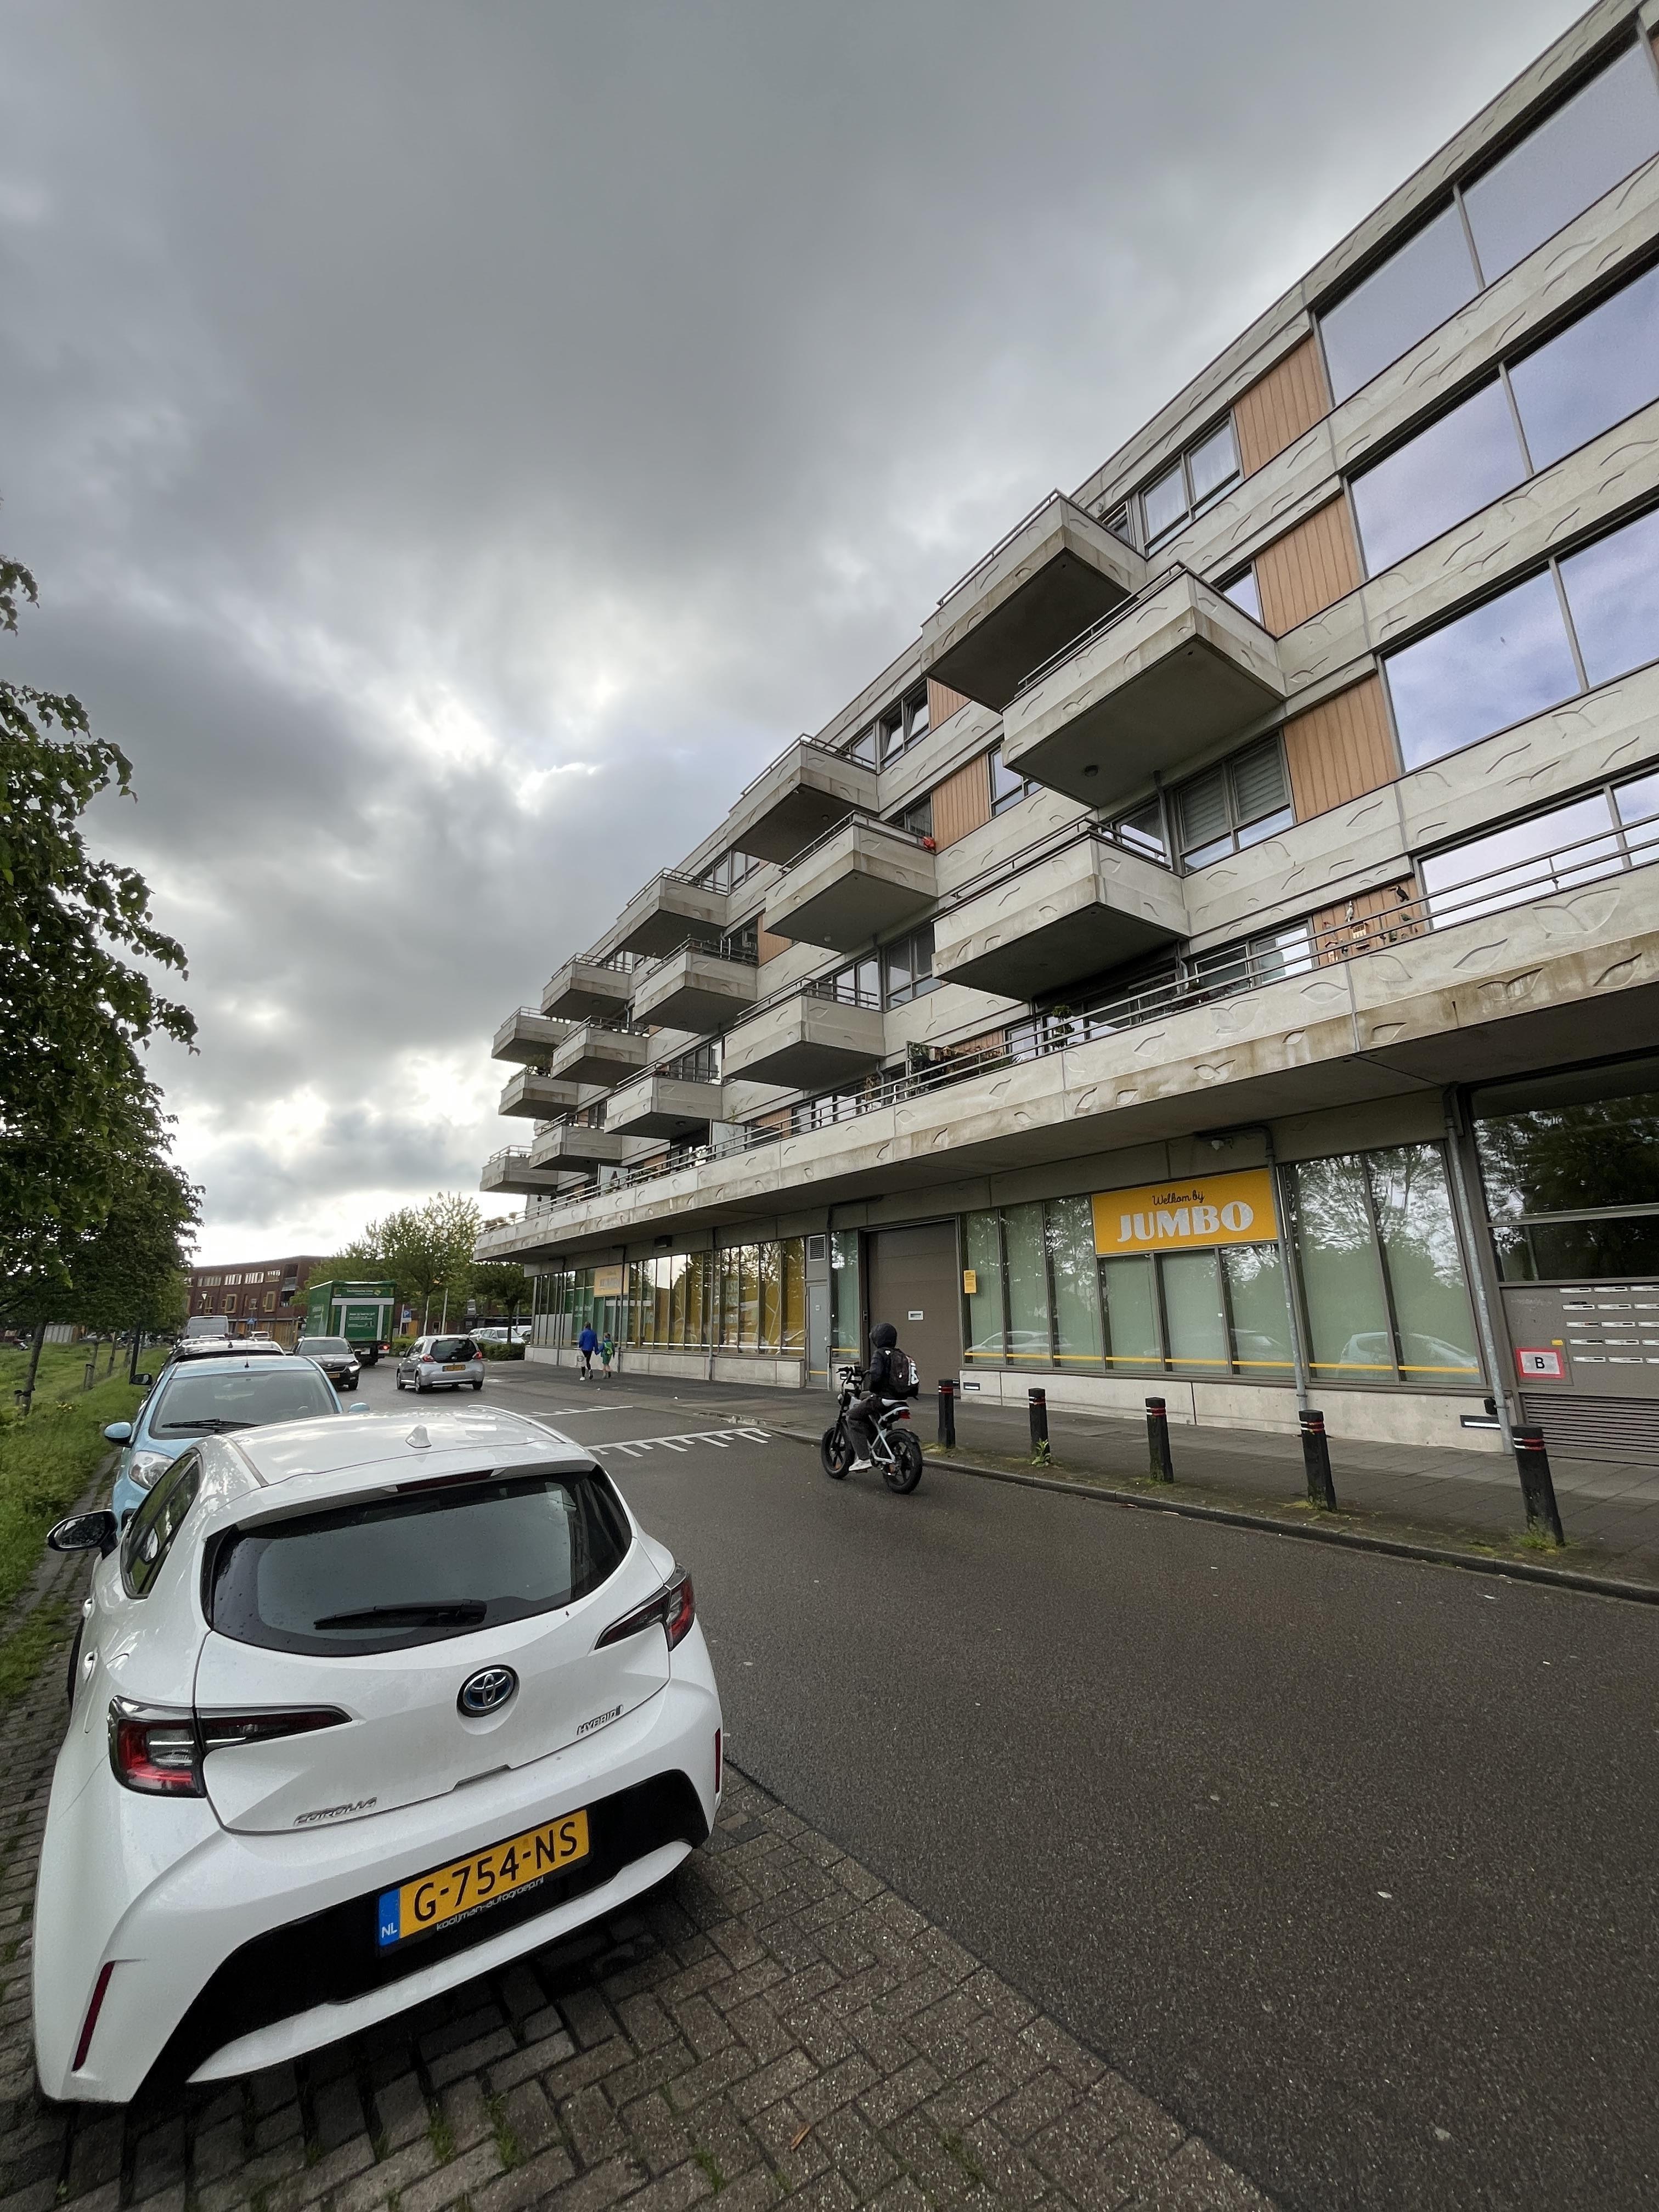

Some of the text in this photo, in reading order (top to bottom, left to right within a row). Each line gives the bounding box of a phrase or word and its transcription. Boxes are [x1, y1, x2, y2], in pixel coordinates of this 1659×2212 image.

[1152, 1193, 1192, 1206] Welkom
[1117, 1200, 1254, 1243] JUMBO
[1534, 1357, 1545, 1369] B
[576, 1708, 617, 1736] HYBRID
[294, 1796, 377, 1826] COROLLA
[414, 1821, 577, 1922] G-754-NS
[381, 1922, 398, 1939] NL
